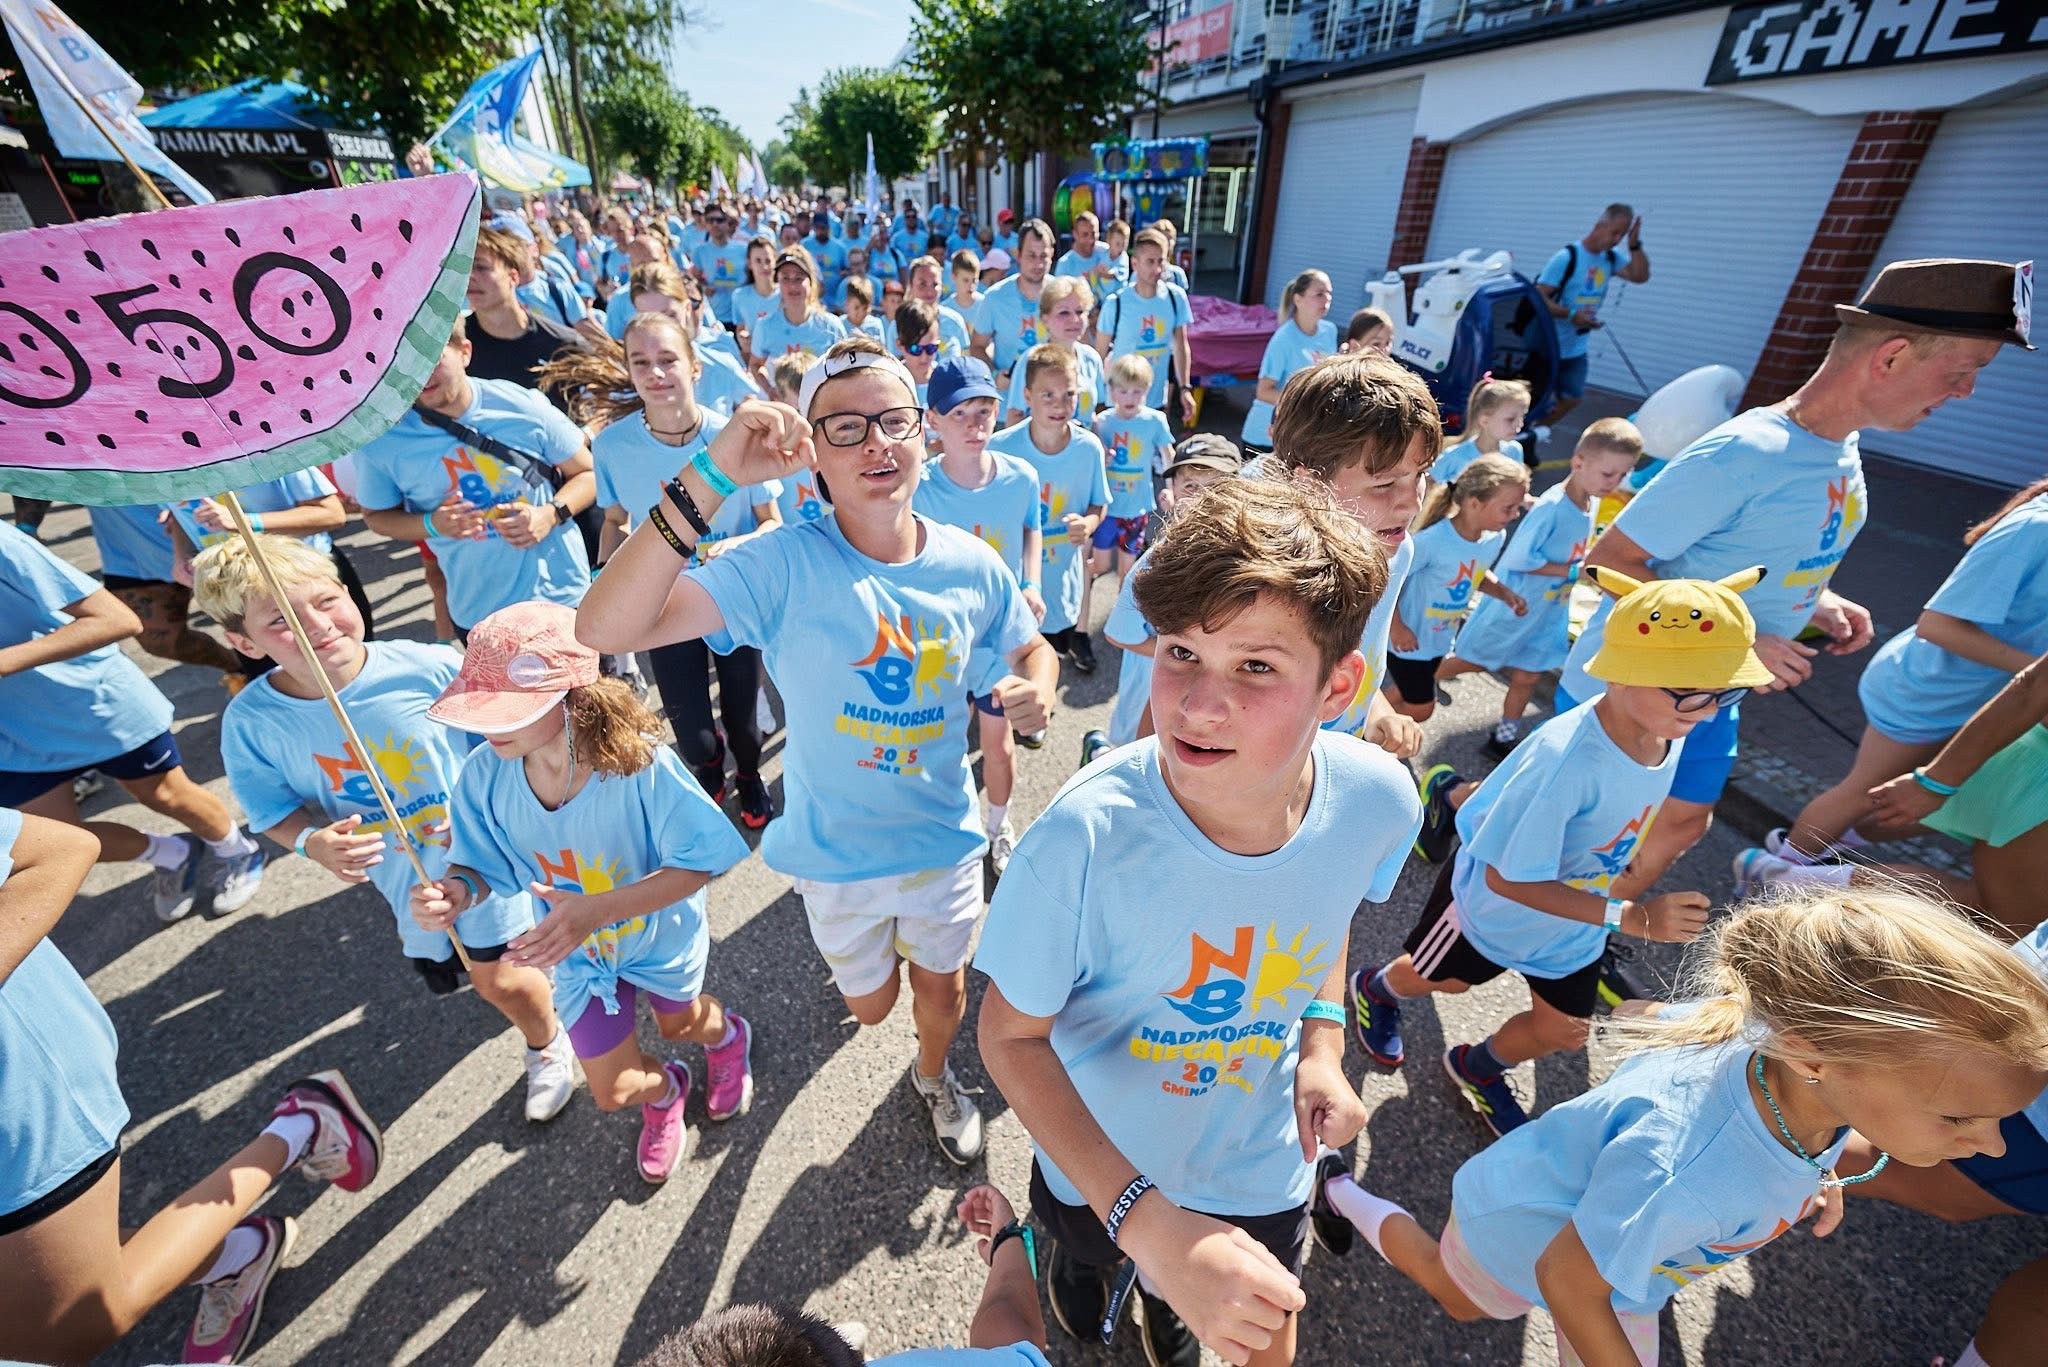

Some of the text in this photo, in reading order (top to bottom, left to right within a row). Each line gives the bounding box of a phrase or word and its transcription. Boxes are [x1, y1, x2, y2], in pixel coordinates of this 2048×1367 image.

[1730, 0, 2004, 77] GAME
[848, 608, 915, 667] N
[854, 655, 914, 706] B
[843, 702, 945, 727] NADMORSKA
[872, 747, 919, 765] 2025
[1158, 926, 1255, 999] N
[1162, 978, 1246, 1026] B
[1161, 1080, 1209, 1097] GMINA
